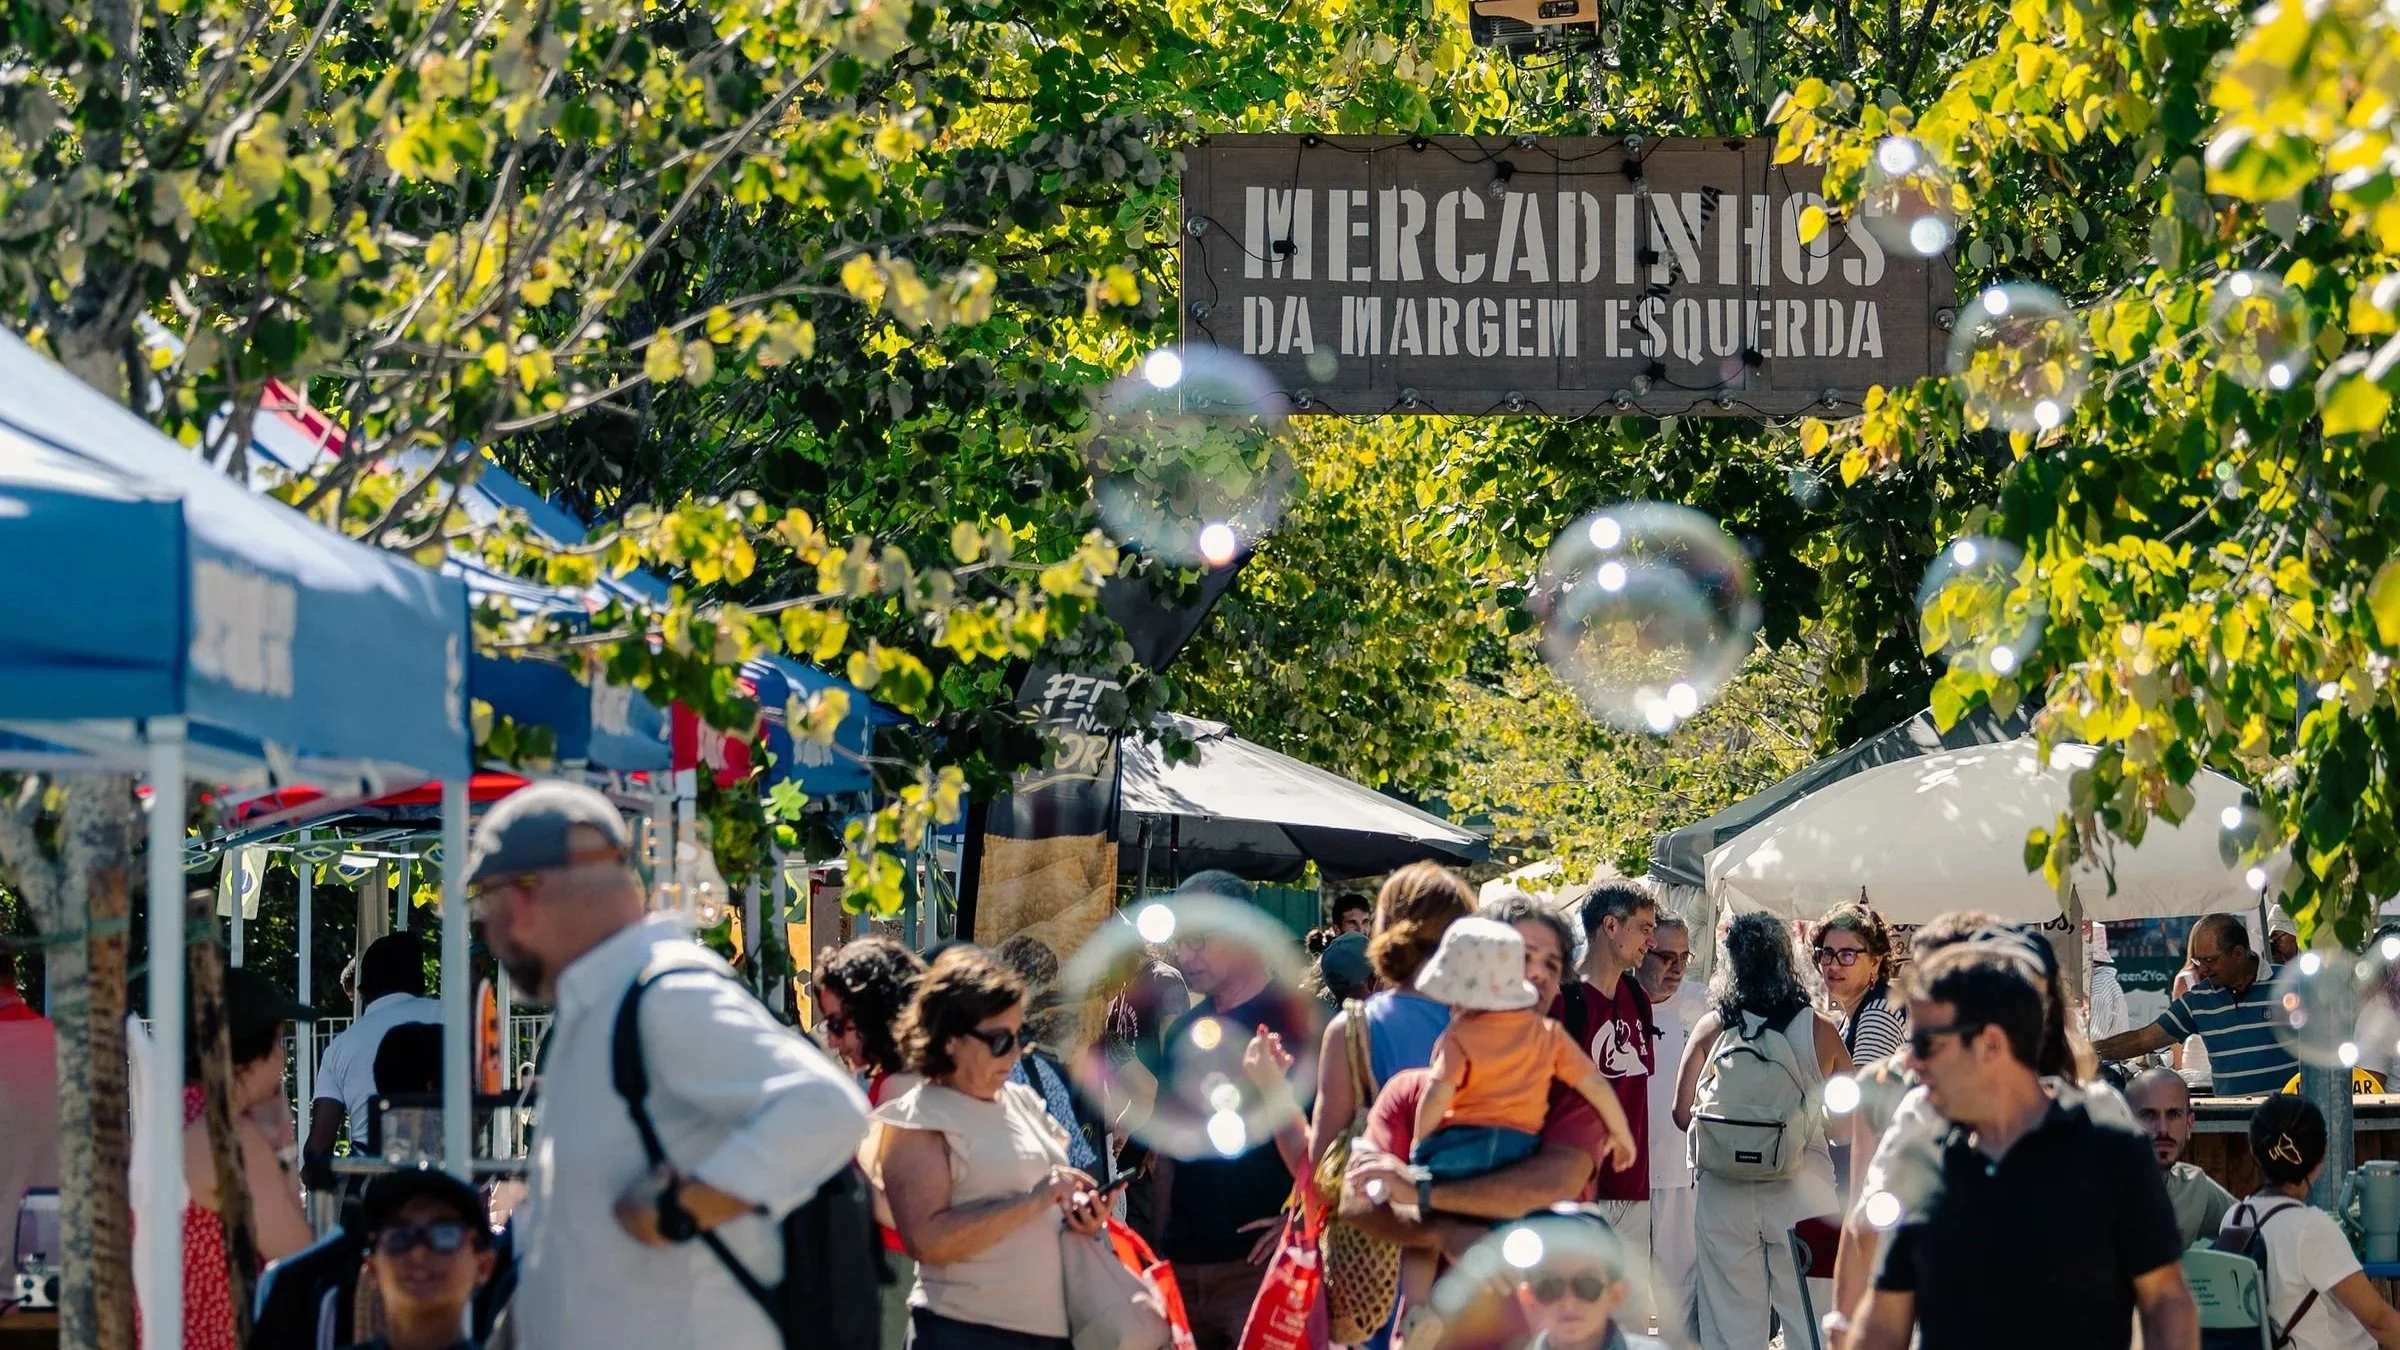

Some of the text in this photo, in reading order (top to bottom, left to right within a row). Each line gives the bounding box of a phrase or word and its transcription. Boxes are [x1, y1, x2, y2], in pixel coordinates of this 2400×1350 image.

[1244, 186, 1886, 286] MERCADINHOS
[1243, 296, 1884, 366] DA MARGEM ESQUERDA
